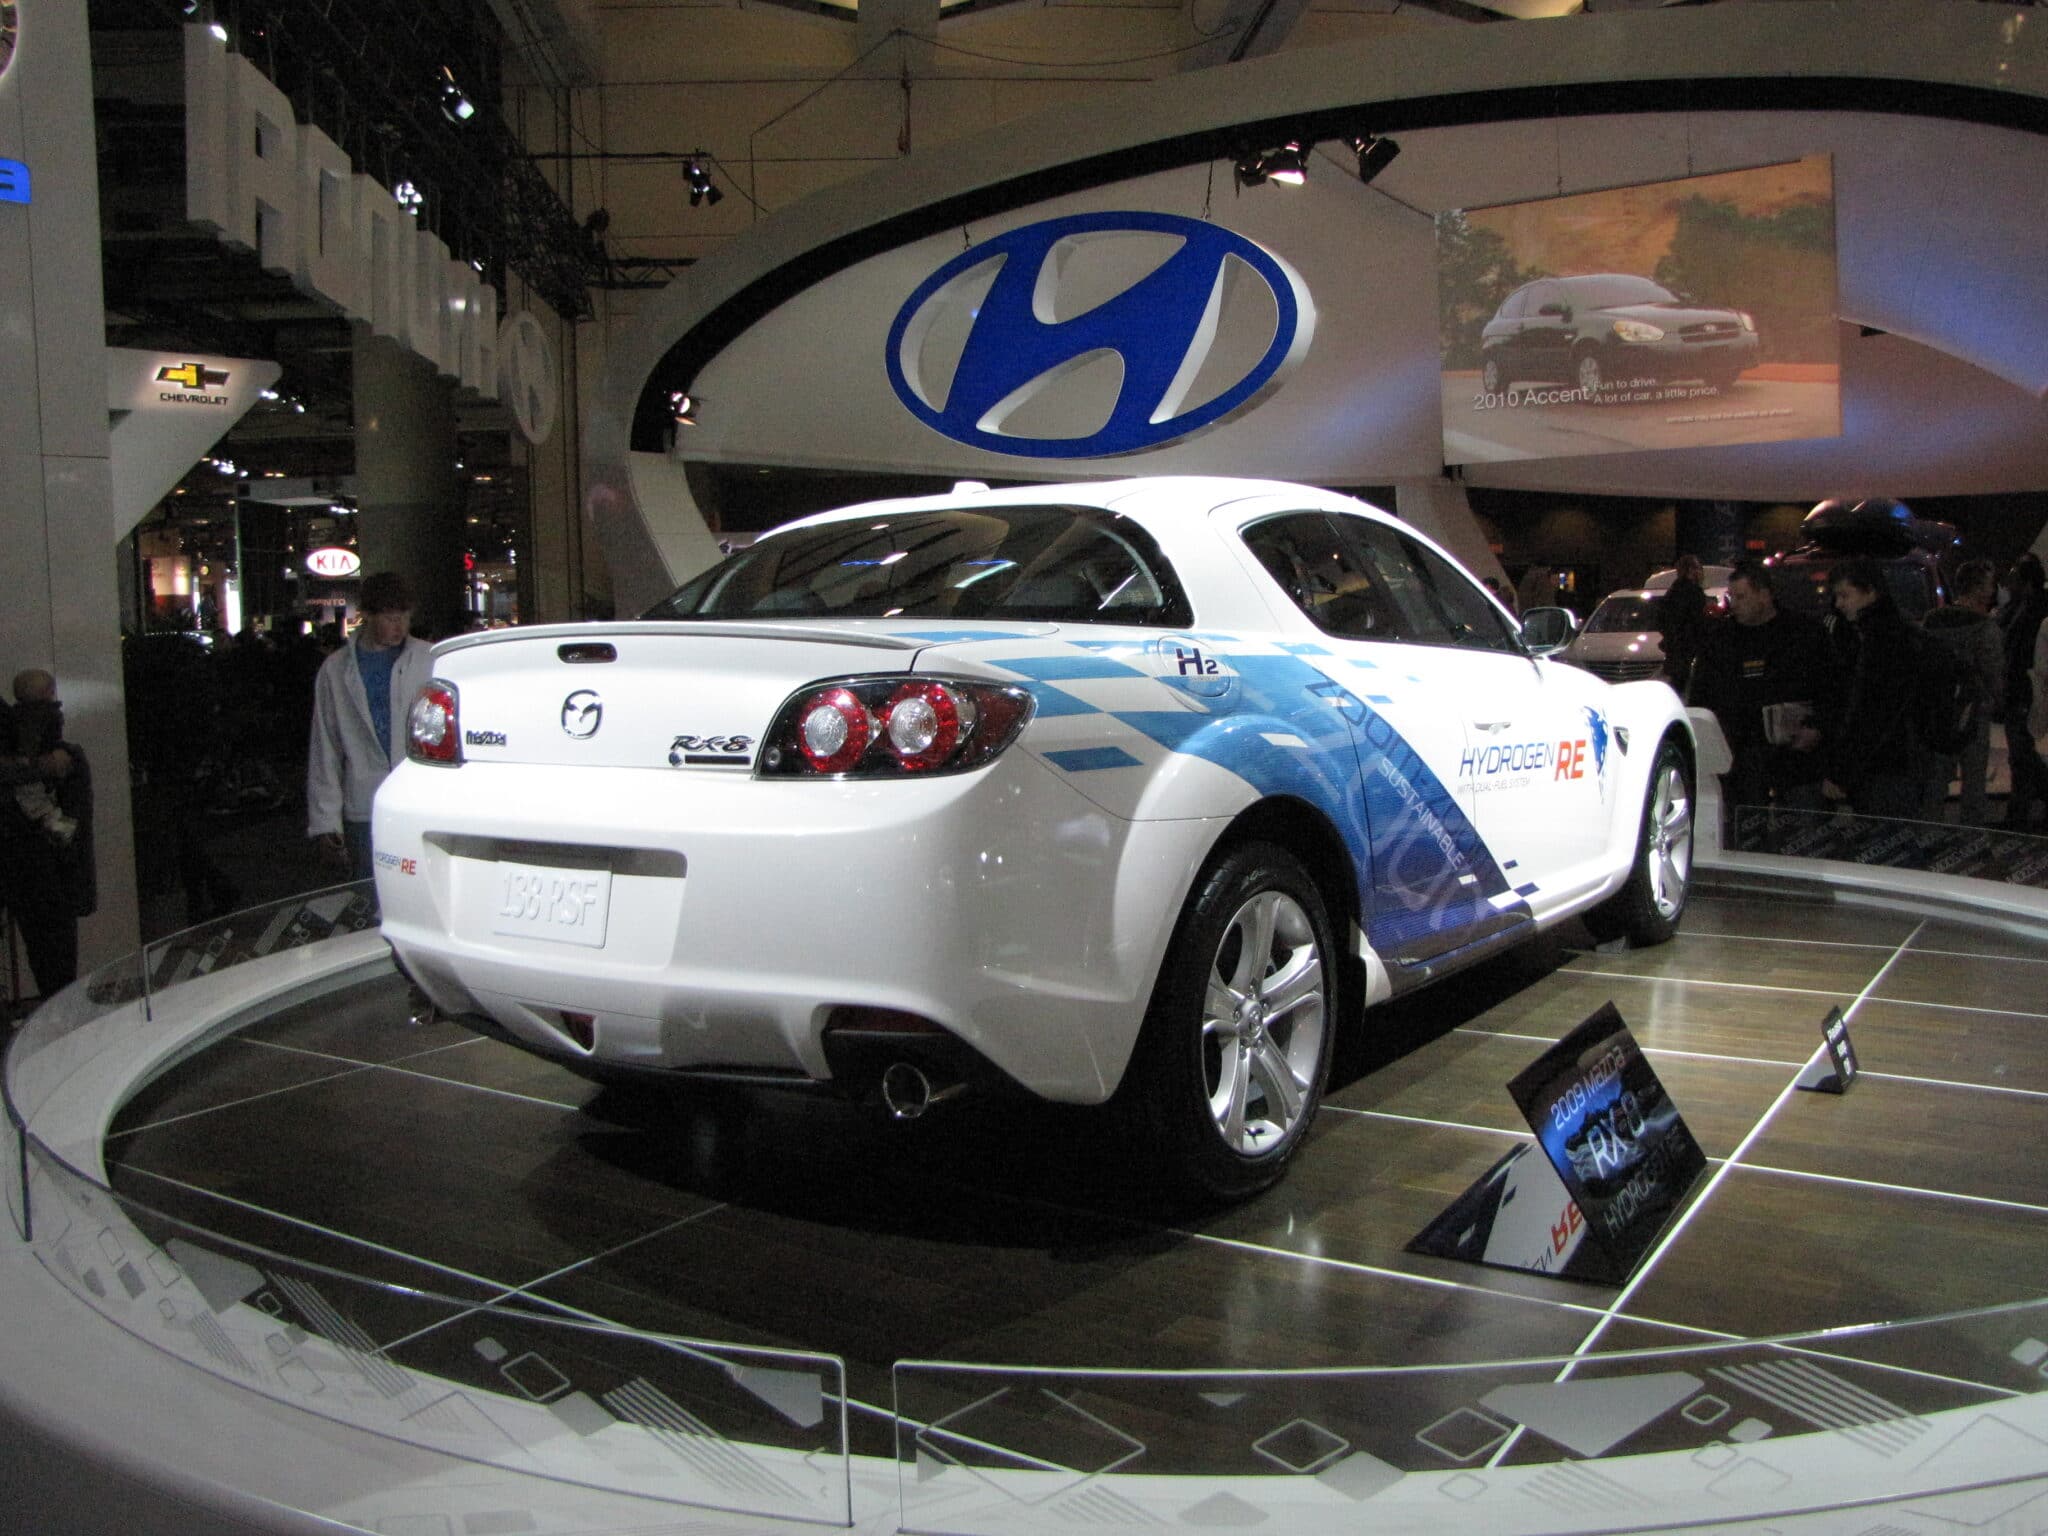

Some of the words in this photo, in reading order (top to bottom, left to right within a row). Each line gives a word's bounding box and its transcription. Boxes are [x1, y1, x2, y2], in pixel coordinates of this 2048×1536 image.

[1593, 380, 1614, 391] Fun
[1616, 379, 1627, 389] to
[160, 392, 228, 405] CHEVROLET
[1473, 391, 1519, 410] 2010
[1524, 385, 1590, 406] Accent
[1593, 394, 1602, 404] A
[1604, 392, 1617, 403] lot
[1620, 391, 1631, 402] of
[1655, 391, 1663, 399] a
[1664, 388, 1687, 399] little
[316, 554, 352, 569] KIA
[670, 735, 755, 752] RX-8
[1458, 742, 1556, 777] HYDROGEN
[1554, 739, 1586, 781] RE
[1379, 757, 1465, 871] SUSTAINABLE
[401, 857, 417, 876] RE
[1550, 1082, 1587, 1131] 2009
